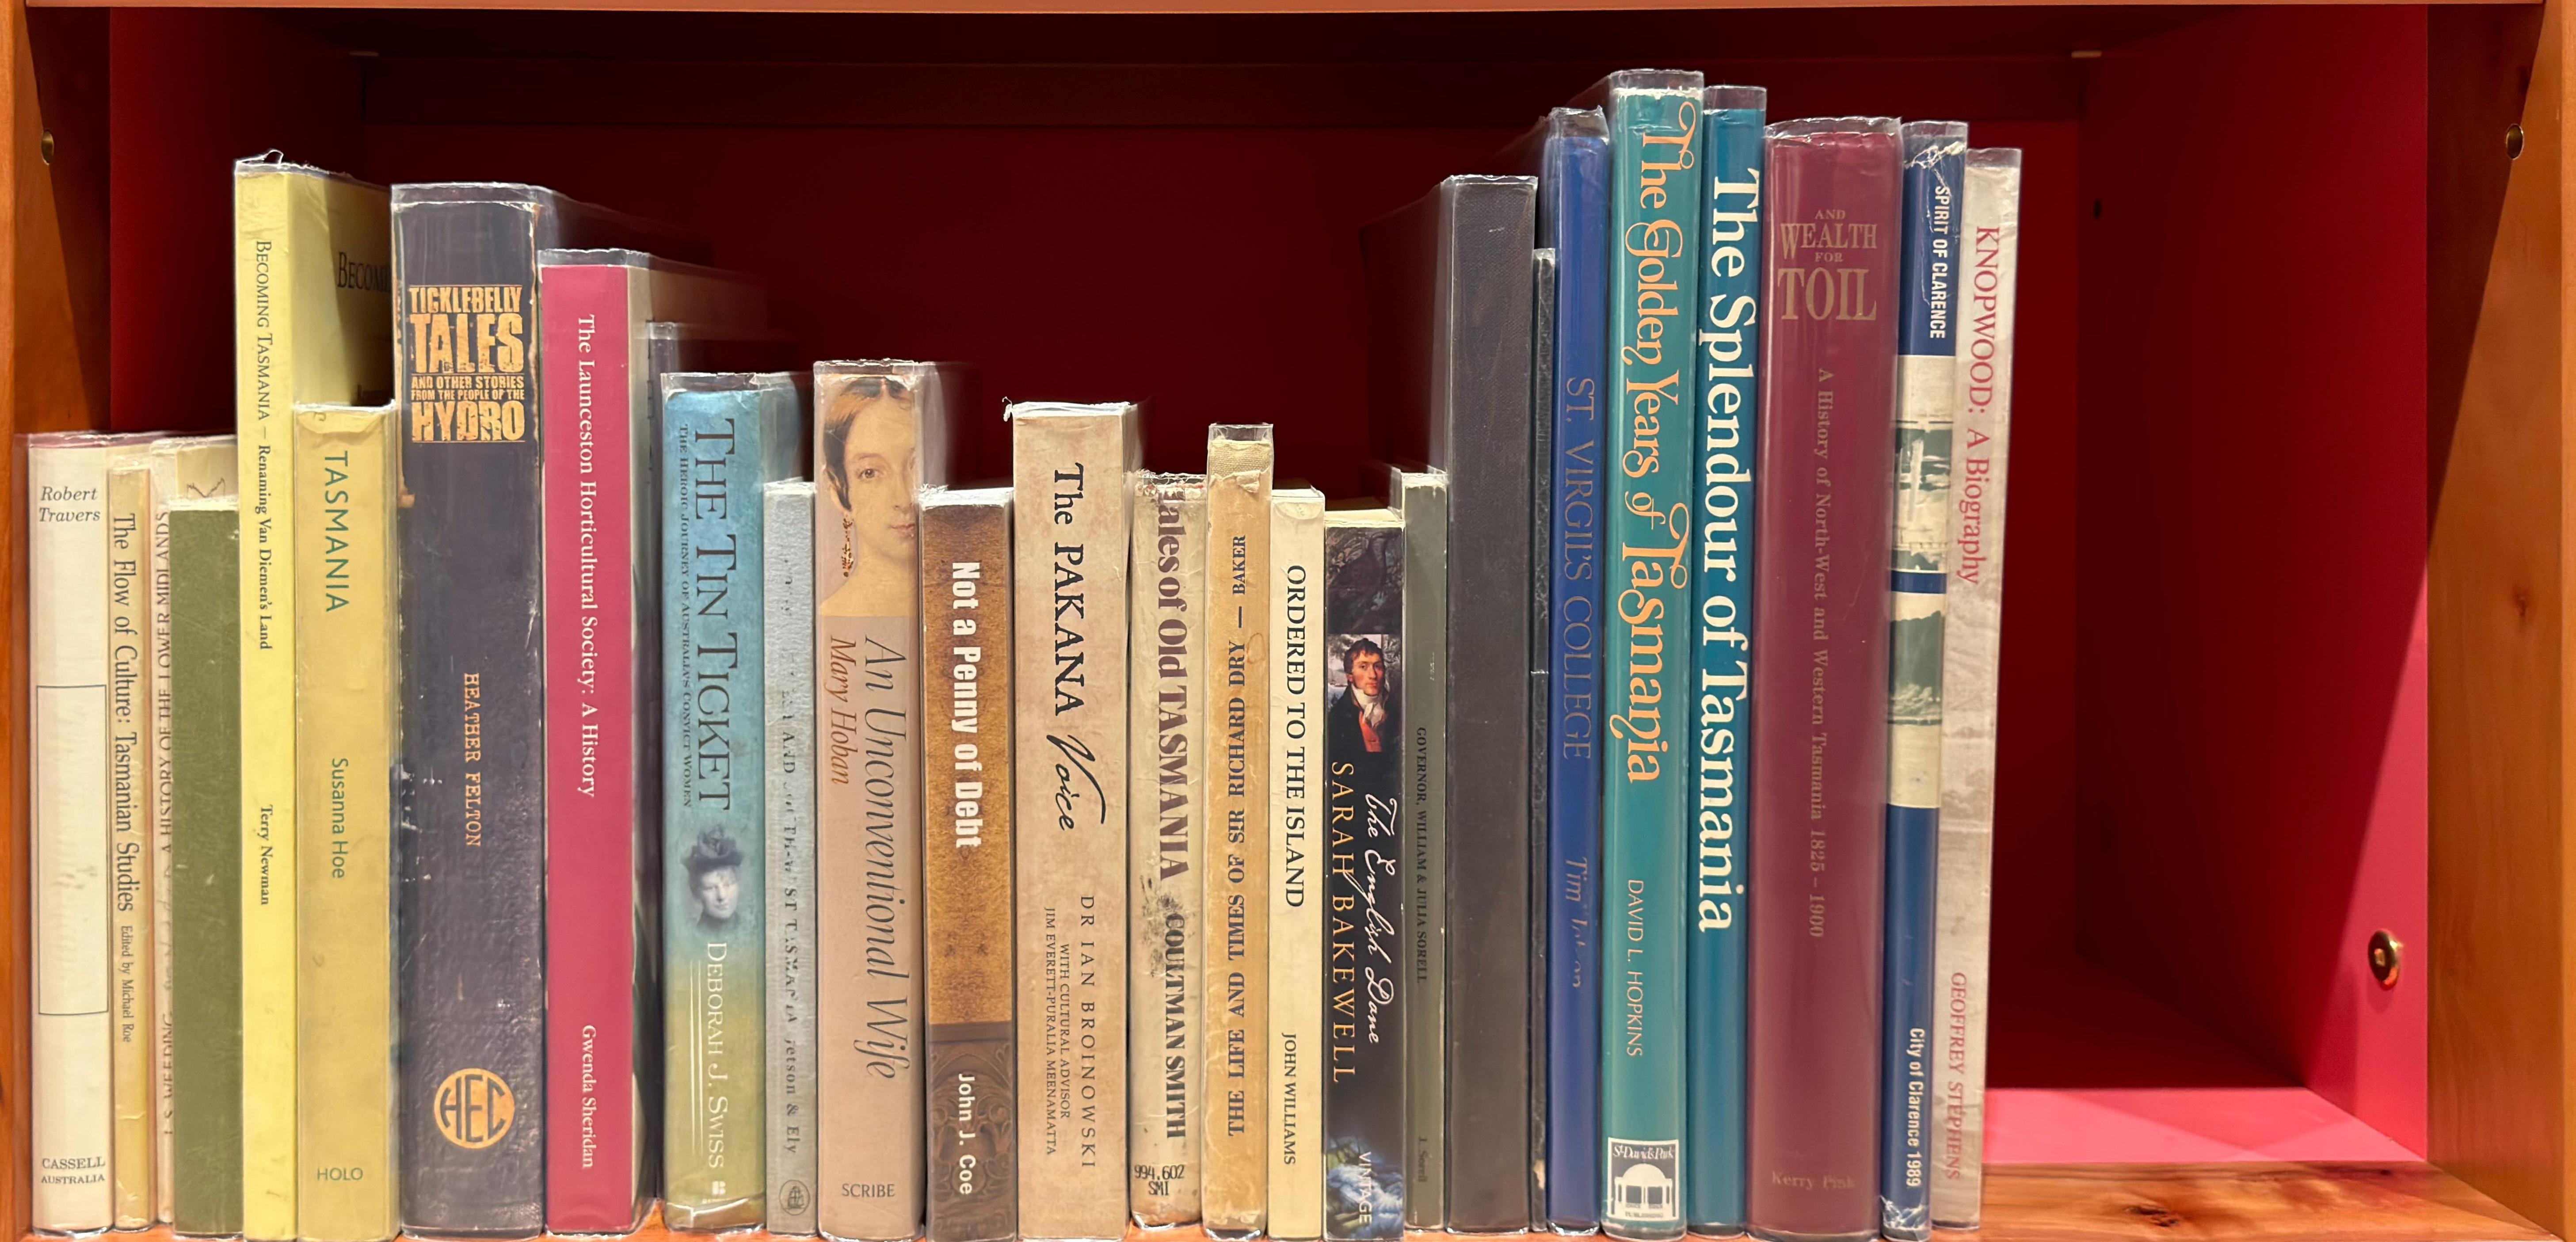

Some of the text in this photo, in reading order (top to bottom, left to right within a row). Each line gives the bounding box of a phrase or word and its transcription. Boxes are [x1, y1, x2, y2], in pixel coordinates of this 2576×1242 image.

[1780, 223, 1878, 260] WEALTH
[1814, 252, 1843, 262] FOR
[1815, 210, 1846, 220] AND
[1930, 186, 1950, 339] SPIRIT OF CLARENCE
[409, 287, 523, 313] TICKLEBELLY
[410, 312, 524, 374] TALES
[1777, 267, 1877, 320] TOIL
[255, 241, 273, 650] BECOMING TASMANIA Renaming Van Diemen's Land
[411, 376, 525, 389] AND OTHER STORIES
[411, 389, 525, 401] FROM THE PEOPLE OF THE
[411, 400, 525, 442] HYDRO
[1610, 102, 1696, 783] The Golden Years of Tasmania
[1956, 226, 2000, 585] KNOPWOOD: A Biography
[39, 507, 101, 522] Travers
[41, 486, 97, 501] Robert
[325, 451, 350, 613] TASMANIA
[577, 313, 598, 797] The Launceston Horticultural Society: A History
[1563, 377, 1594, 759] ST. VIRGIL'S COLLEGE
[1699, 168, 1760, 933] The Splendour of Tasmania
[679, 424, 693, 808] THE HEROIC JOURNEY OF AUSTRALIA'S CONVICT WOMEN
[695, 418, 738, 810] THE TIN TICKET
[1046, 462, 1106, 831] The PAKANA Voice
[1158, 576, 1188, 612] of
[1158, 619, 1188, 678] Old
[1809, 368, 1833, 937] A History of North-West and Western Tasmania 1825 1900
[114, 513, 140, 912] The Flow of Culture: Tasmanian Studies
[464, 672, 481, 847] HEATHER FELTON
[824, 635, 858, 785] Mary Hoban
[1158, 685, 1189, 881] TASMANIA
[332, 757, 349, 879] Susanna Hoe
[854, 635, 910, 1079] An Unconventional Wife
[1228, 535, 1246, 1137] THE LIFE AND TIMES OF SIR RICHARD DRY BAKER
[1415, 727, 1427, 984] GOVERNOR, WILLIAM & JULIA SORELL
[119, 926, 134, 1042] Edited by Michael Roe
[1331, 761, 1356, 1083] SARAH BAKEWELL
[1342, 794, 1398, 1044] The English Dane
[1627, 879, 1643, 1057] DAVID L. HOPKINS
[582, 1025, 597, 1169] Gwenda Sheridan
[707, 942, 728, 1168] DEBORAH J. SWISS
[1045, 907, 1057, 1155] JIM EVERETT-PURALIA MEENAMATTA
[1060, 943, 1071, 1119] WITH CULTURAL ADVISOR
[1081, 895, 1096, 1167] DR IAN BROINOWSKI
[1165, 913, 1186, 1139] COULTMAN SMITH
[1281, 1032, 1296, 1165] JOHN WILLIAMS
[1946, 972, 1967, 1180] GEOFFREY STEPHENS
[41, 1173, 106, 1185] AUSTRALIA
[42, 1156, 106, 1170] CASSELL
[317, 1167, 363, 1181] HOLO
[439, 1074, 506, 1143] HEC
[959, 1073, 976, 1194] John J. Coe
[1134, 1164, 1185, 1181] 994.602
[1905, 1028, 1925, 1187] City of Clarence 1989
[842, 1183, 896, 1198] SCRIBE
[1148, 1181, 1170, 1196] SMI
[1359, 1151, 1372, 1224] VINTAGE
